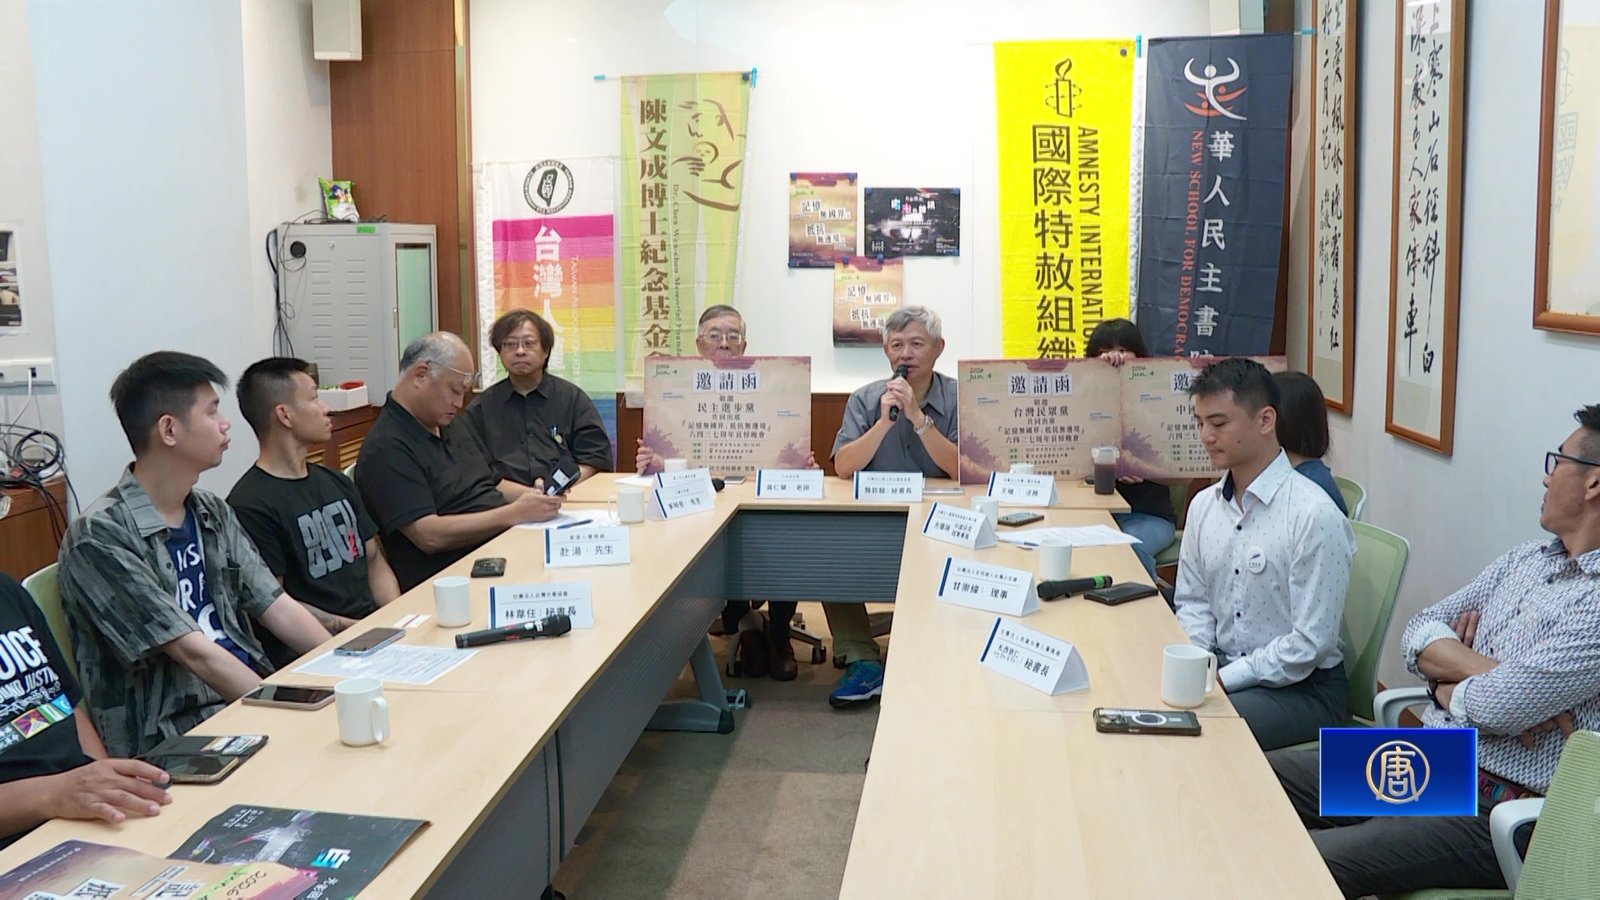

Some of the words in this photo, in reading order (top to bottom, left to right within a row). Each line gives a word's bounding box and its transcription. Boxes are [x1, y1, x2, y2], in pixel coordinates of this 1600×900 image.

[1190, 129, 1204, 165] NEW
[1078, 125, 1100, 217] AMNESTY
[672, 202, 680, 226] Chen
[802, 200, 821, 213] 記憶
[1184, 170, 1201, 235] SCHOOL
[639, 98, 671, 357] 陳文成博士紀念基金
[1032, 123, 1076, 359] 國際特赦組織
[1182, 239, 1196, 271] FOR
[571, 254, 580, 294] TAIWAN
[673, 277, 682, 321] Memorial
[696, 372, 757, 391] 邀請函
[1011, 374, 1071, 394] 邀請函
[698, 402, 756, 414] 民主進步黨
[1013, 406, 1070, 418] 台灣民眾黨
[594, 545, 614, 555] 先生
[990, 587, 1009, 600] 理事
[1023, 657, 1051, 677] 秘書長
